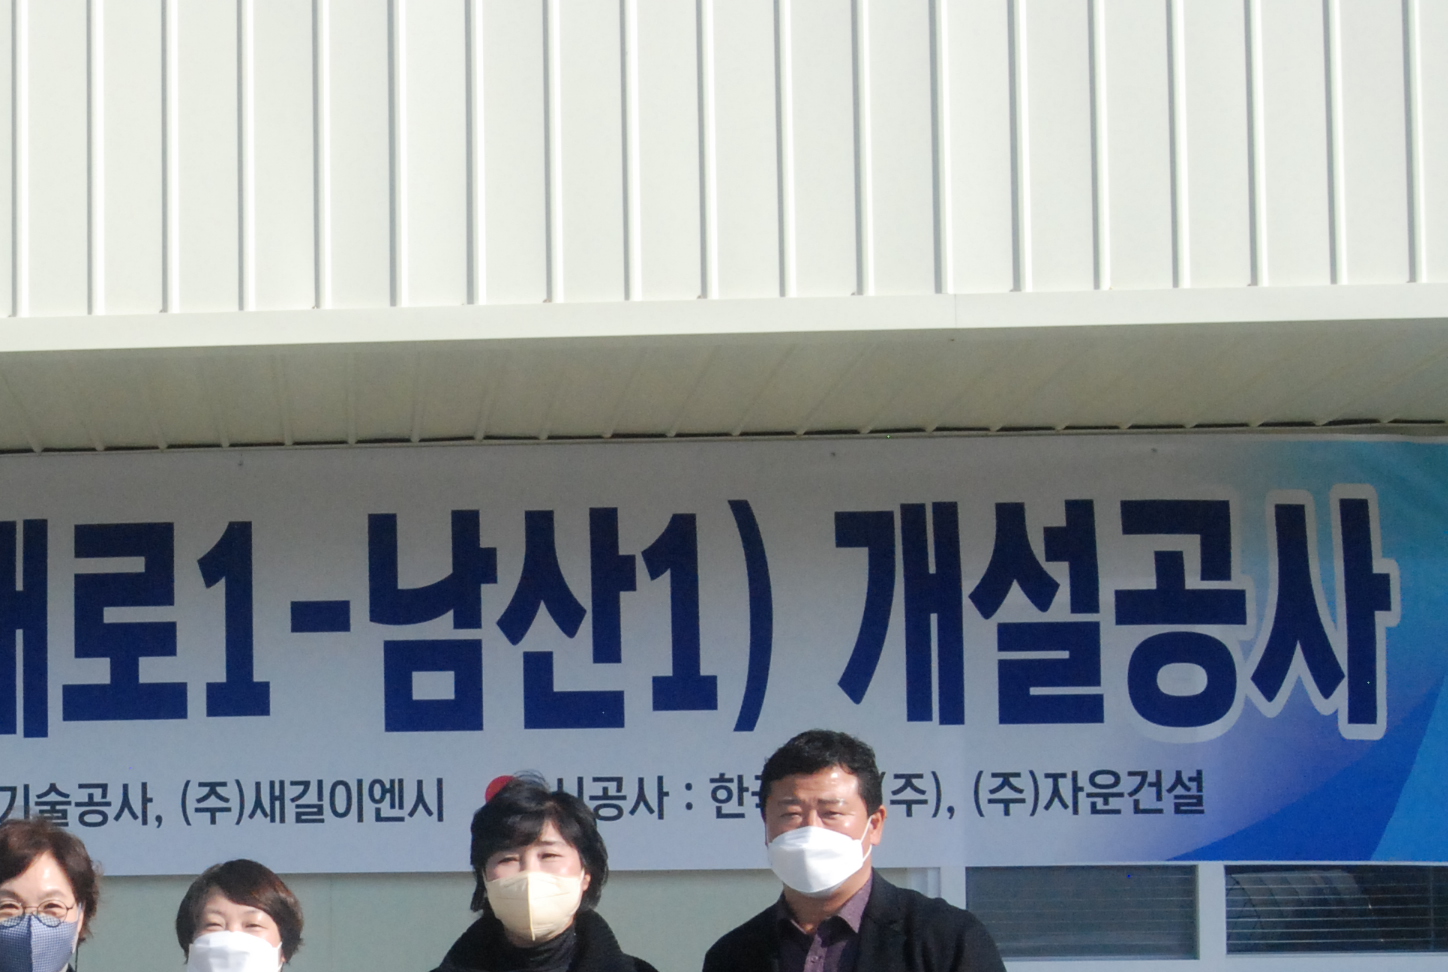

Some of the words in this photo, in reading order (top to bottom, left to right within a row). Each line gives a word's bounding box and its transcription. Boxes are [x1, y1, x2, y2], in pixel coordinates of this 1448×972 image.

[835, 498, 1391, 726] 개설공사
[180, 777, 445, 827] (주)새길이엔시
[973, 768, 1206, 818] (주)자운건설
